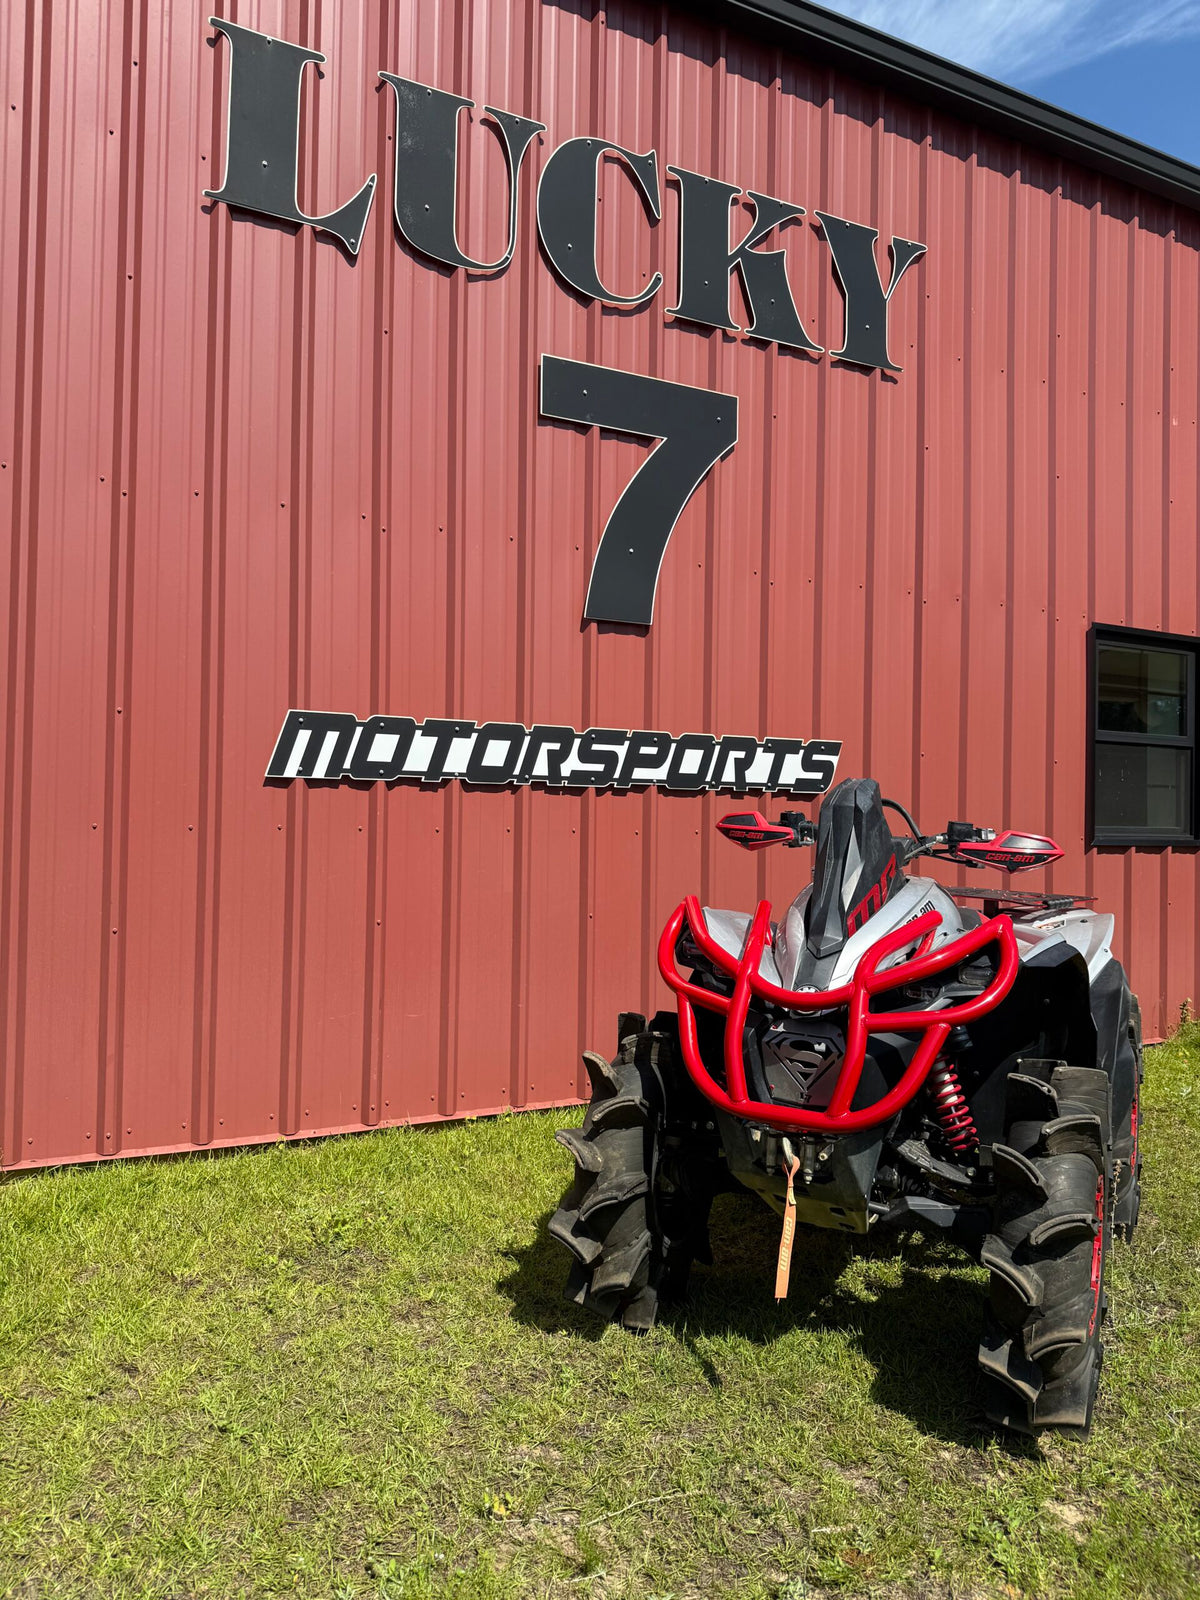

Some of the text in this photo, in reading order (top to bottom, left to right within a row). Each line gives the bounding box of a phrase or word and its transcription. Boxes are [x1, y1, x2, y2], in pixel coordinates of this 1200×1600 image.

[202, 16, 928, 373] LUCKY
[540, 353, 739, 626] 7
[264, 709, 844, 794] MOTORSPORTS
